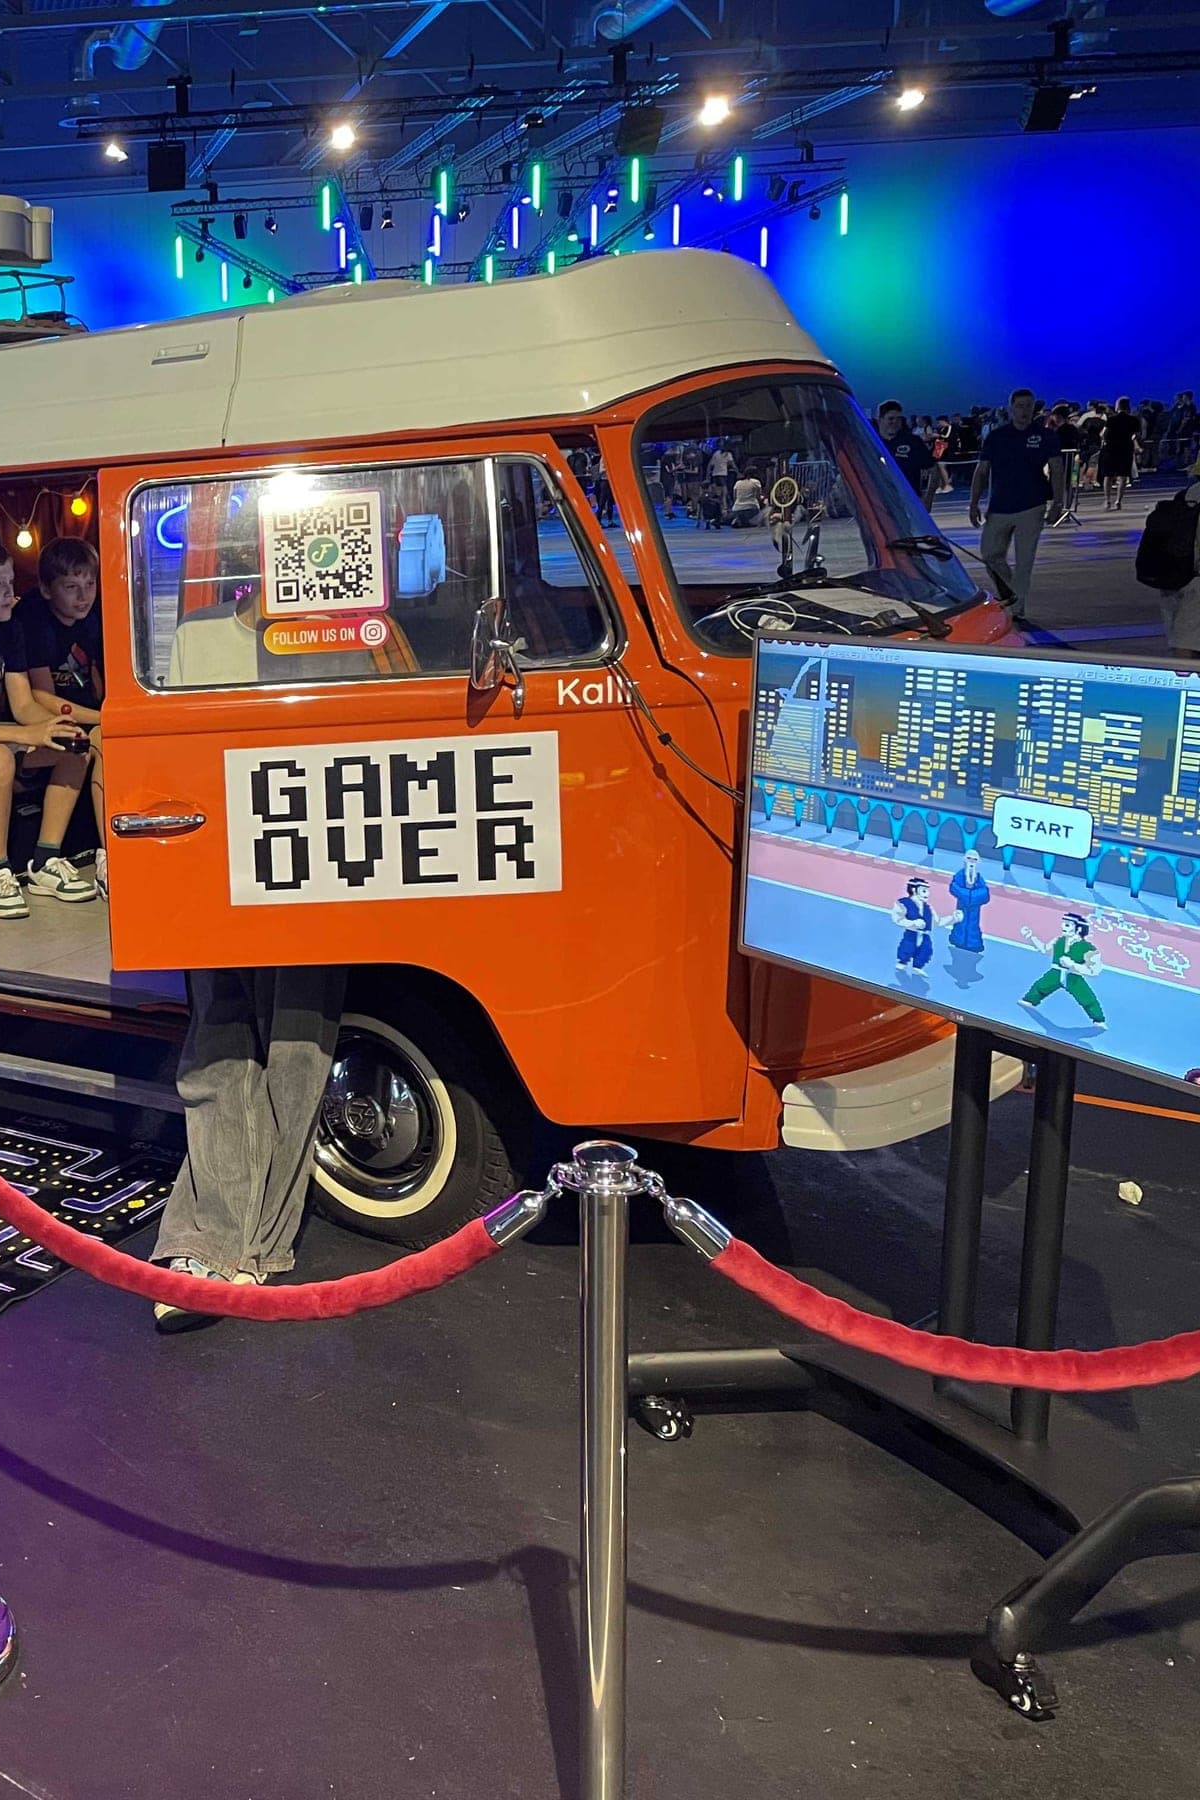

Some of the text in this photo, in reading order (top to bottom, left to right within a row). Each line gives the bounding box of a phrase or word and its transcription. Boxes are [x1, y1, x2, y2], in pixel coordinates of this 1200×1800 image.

[272, 627, 355, 646] FOLLOW US ON
[251, 746, 534, 823] GAME
[1010, 816, 1074, 839] START
[253, 817, 535, 891] OVER
